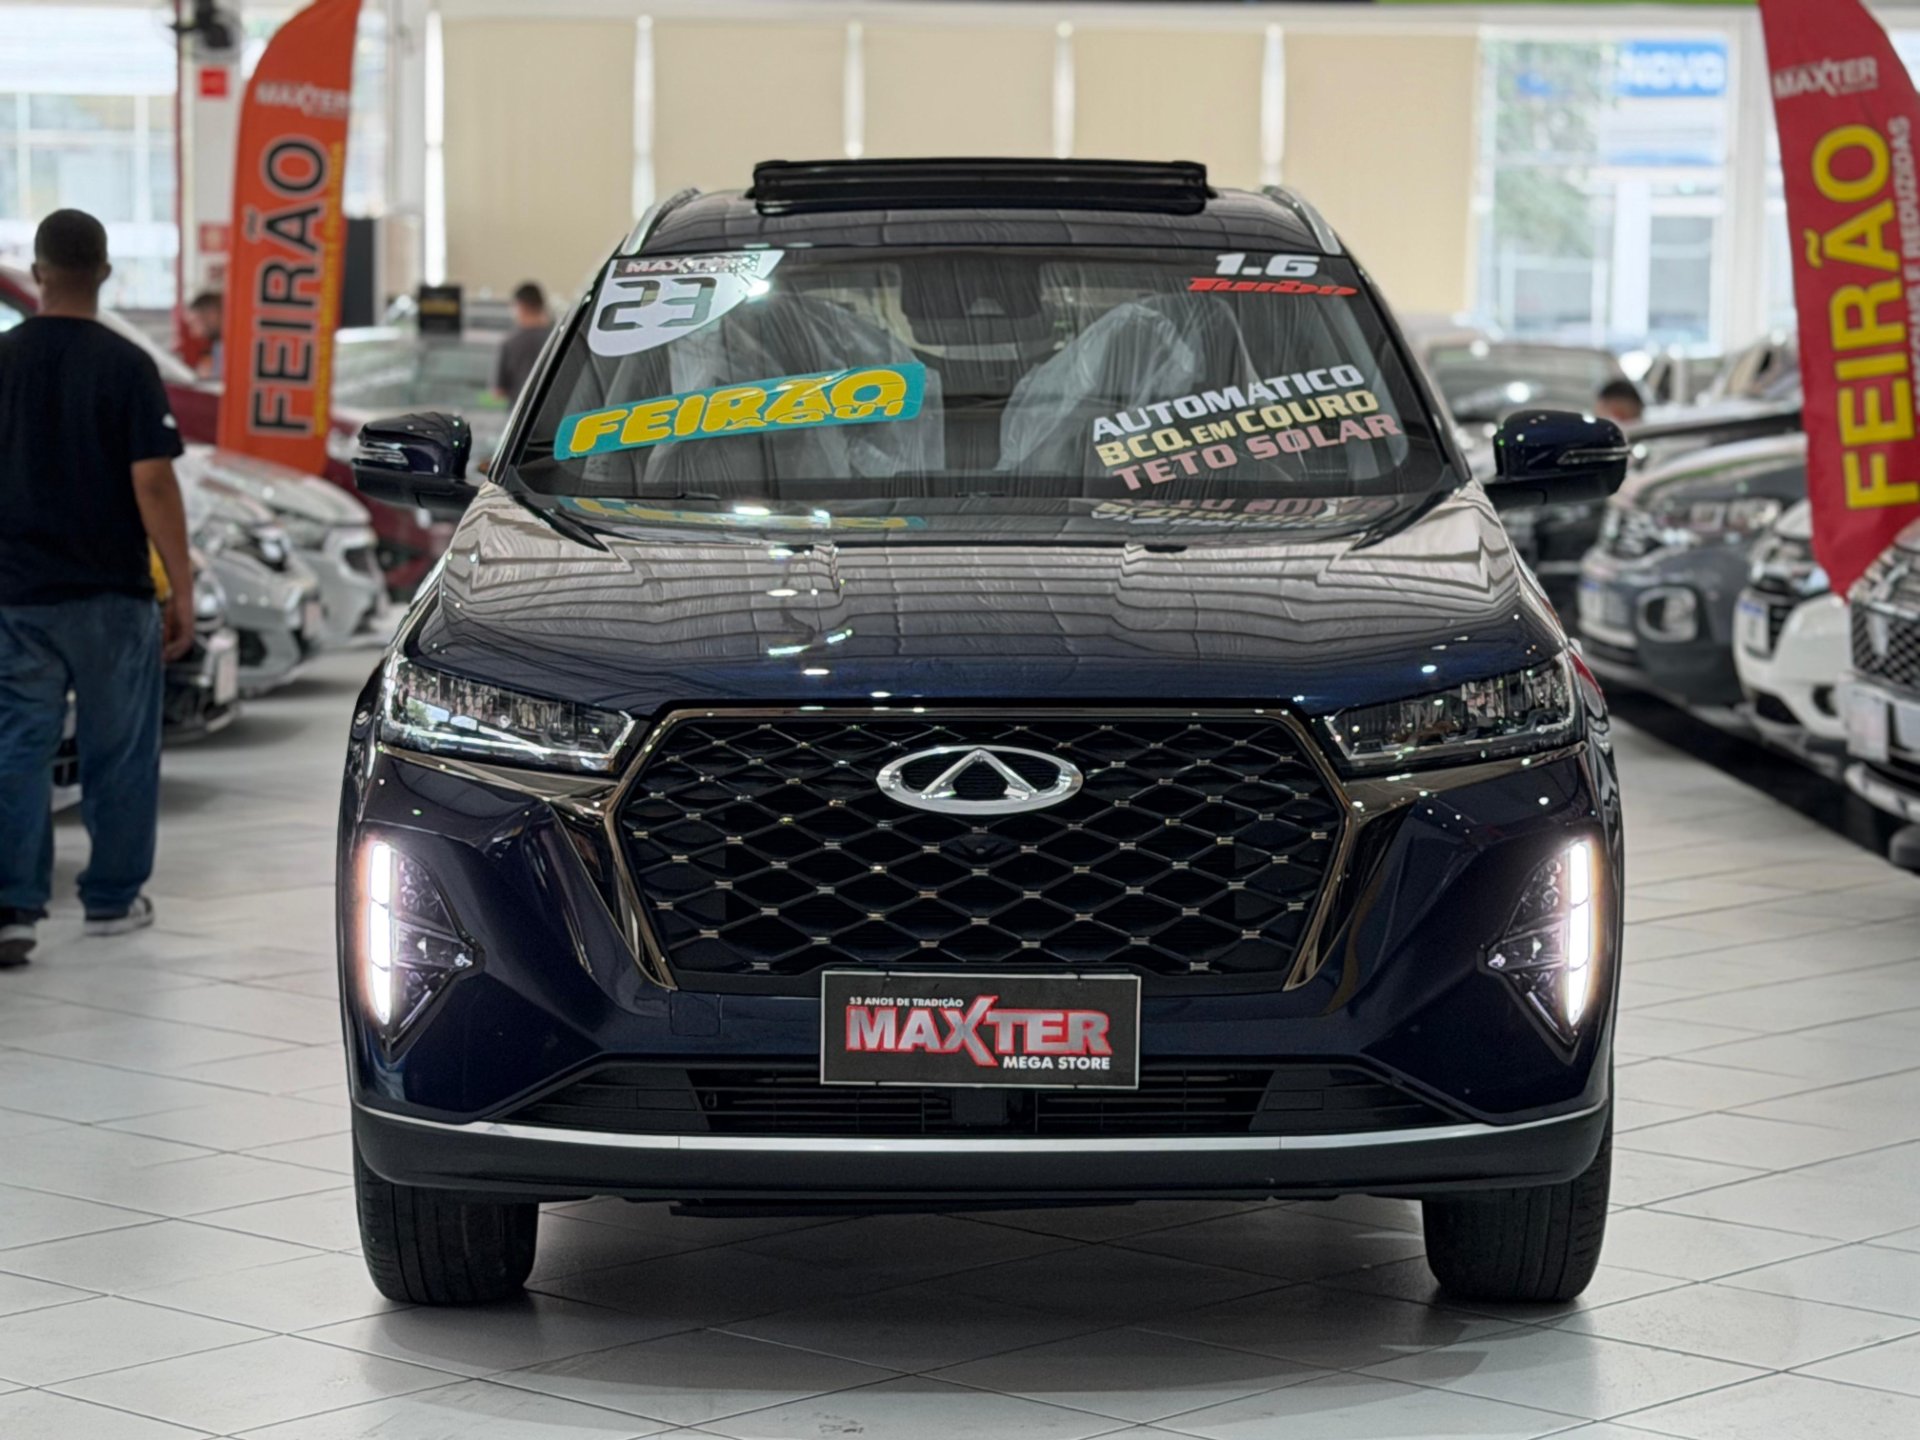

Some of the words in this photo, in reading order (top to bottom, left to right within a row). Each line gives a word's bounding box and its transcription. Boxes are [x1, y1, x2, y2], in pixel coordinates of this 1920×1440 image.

[1773, 57, 1877, 98] MAXTER
[246, 138, 328, 437] FEIRÃO
[1215, 253, 1320, 278] 1.6
[597, 277, 717, 332] 23
[1804, 124, 1920, 511] FEIRÃO
[1189, 420, 1237, 445] EM
[1235, 389, 1379, 434] COURO
[1112, 443, 1237, 491] TETO
[1245, 413, 1403, 461] SOLAR
[864, 996, 894, 1006] ANOS
[896, 998, 910, 1007] DE
[846, 995, 1112, 1067] MAXTER
[1003, 1056, 1052, 1069] MEGA
[1058, 1057, 1110, 1070] STORE
